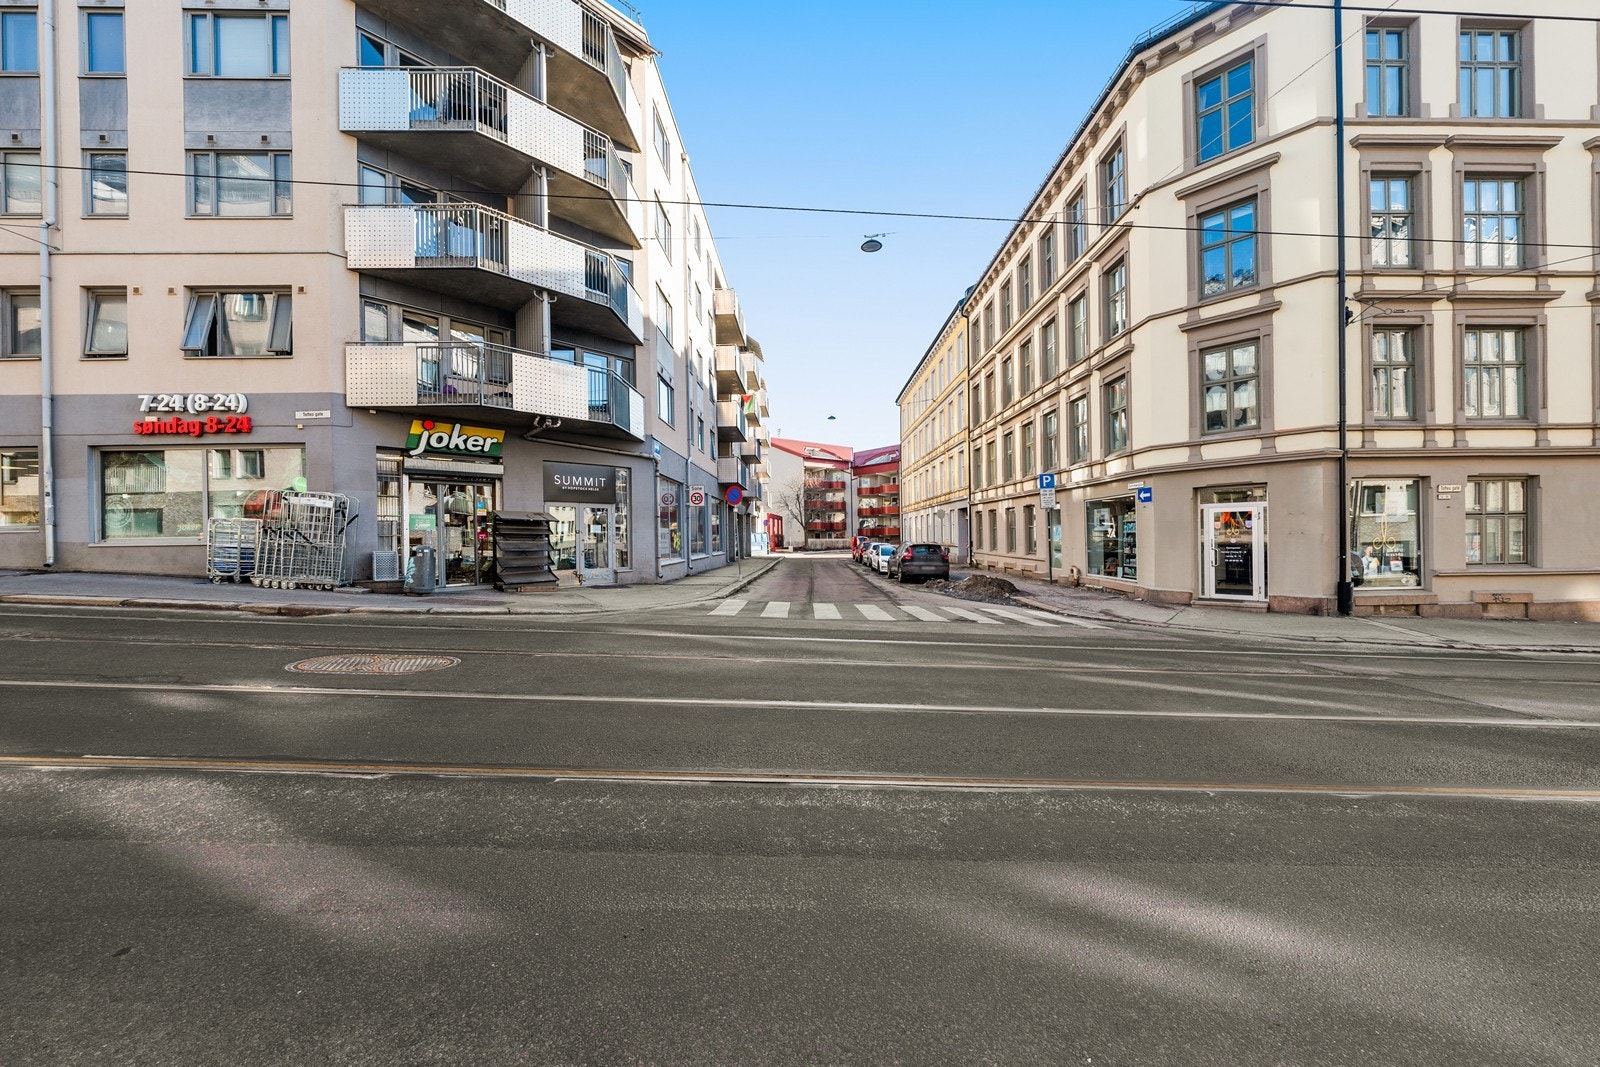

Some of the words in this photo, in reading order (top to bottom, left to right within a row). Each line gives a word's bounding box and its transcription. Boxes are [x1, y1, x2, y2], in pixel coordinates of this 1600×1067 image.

[138, 393, 184, 413] 7-24
[186, 393, 248, 415] (8-24)
[133, 416, 202, 438] søndag
[205, 415, 251, 433] 8-24
[409, 420, 498, 456] joker
[554, 474, 607, 488] SUMMIT
[1042, 475, 1051, 487] P
